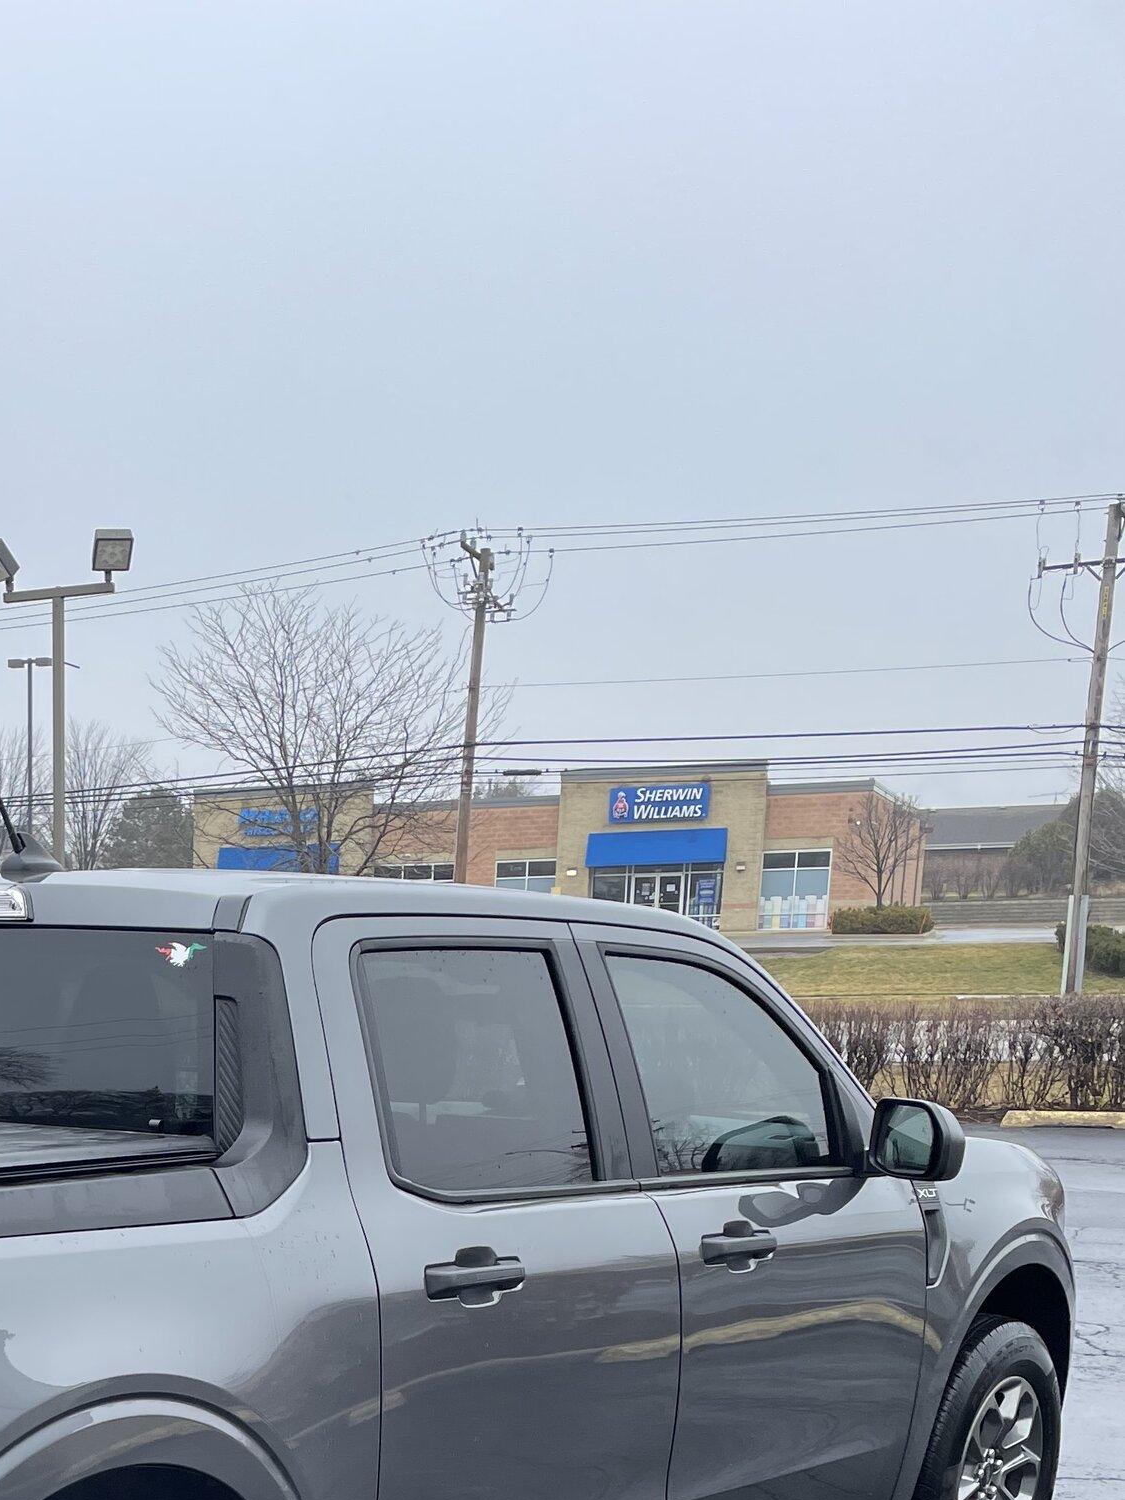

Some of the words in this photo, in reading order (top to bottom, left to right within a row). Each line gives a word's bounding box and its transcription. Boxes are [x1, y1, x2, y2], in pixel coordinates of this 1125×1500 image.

[635, 788, 703, 803] SHERWIN
[633, 804, 703, 820] WILLIAMS
[916, 1188, 937, 1199] XLT
